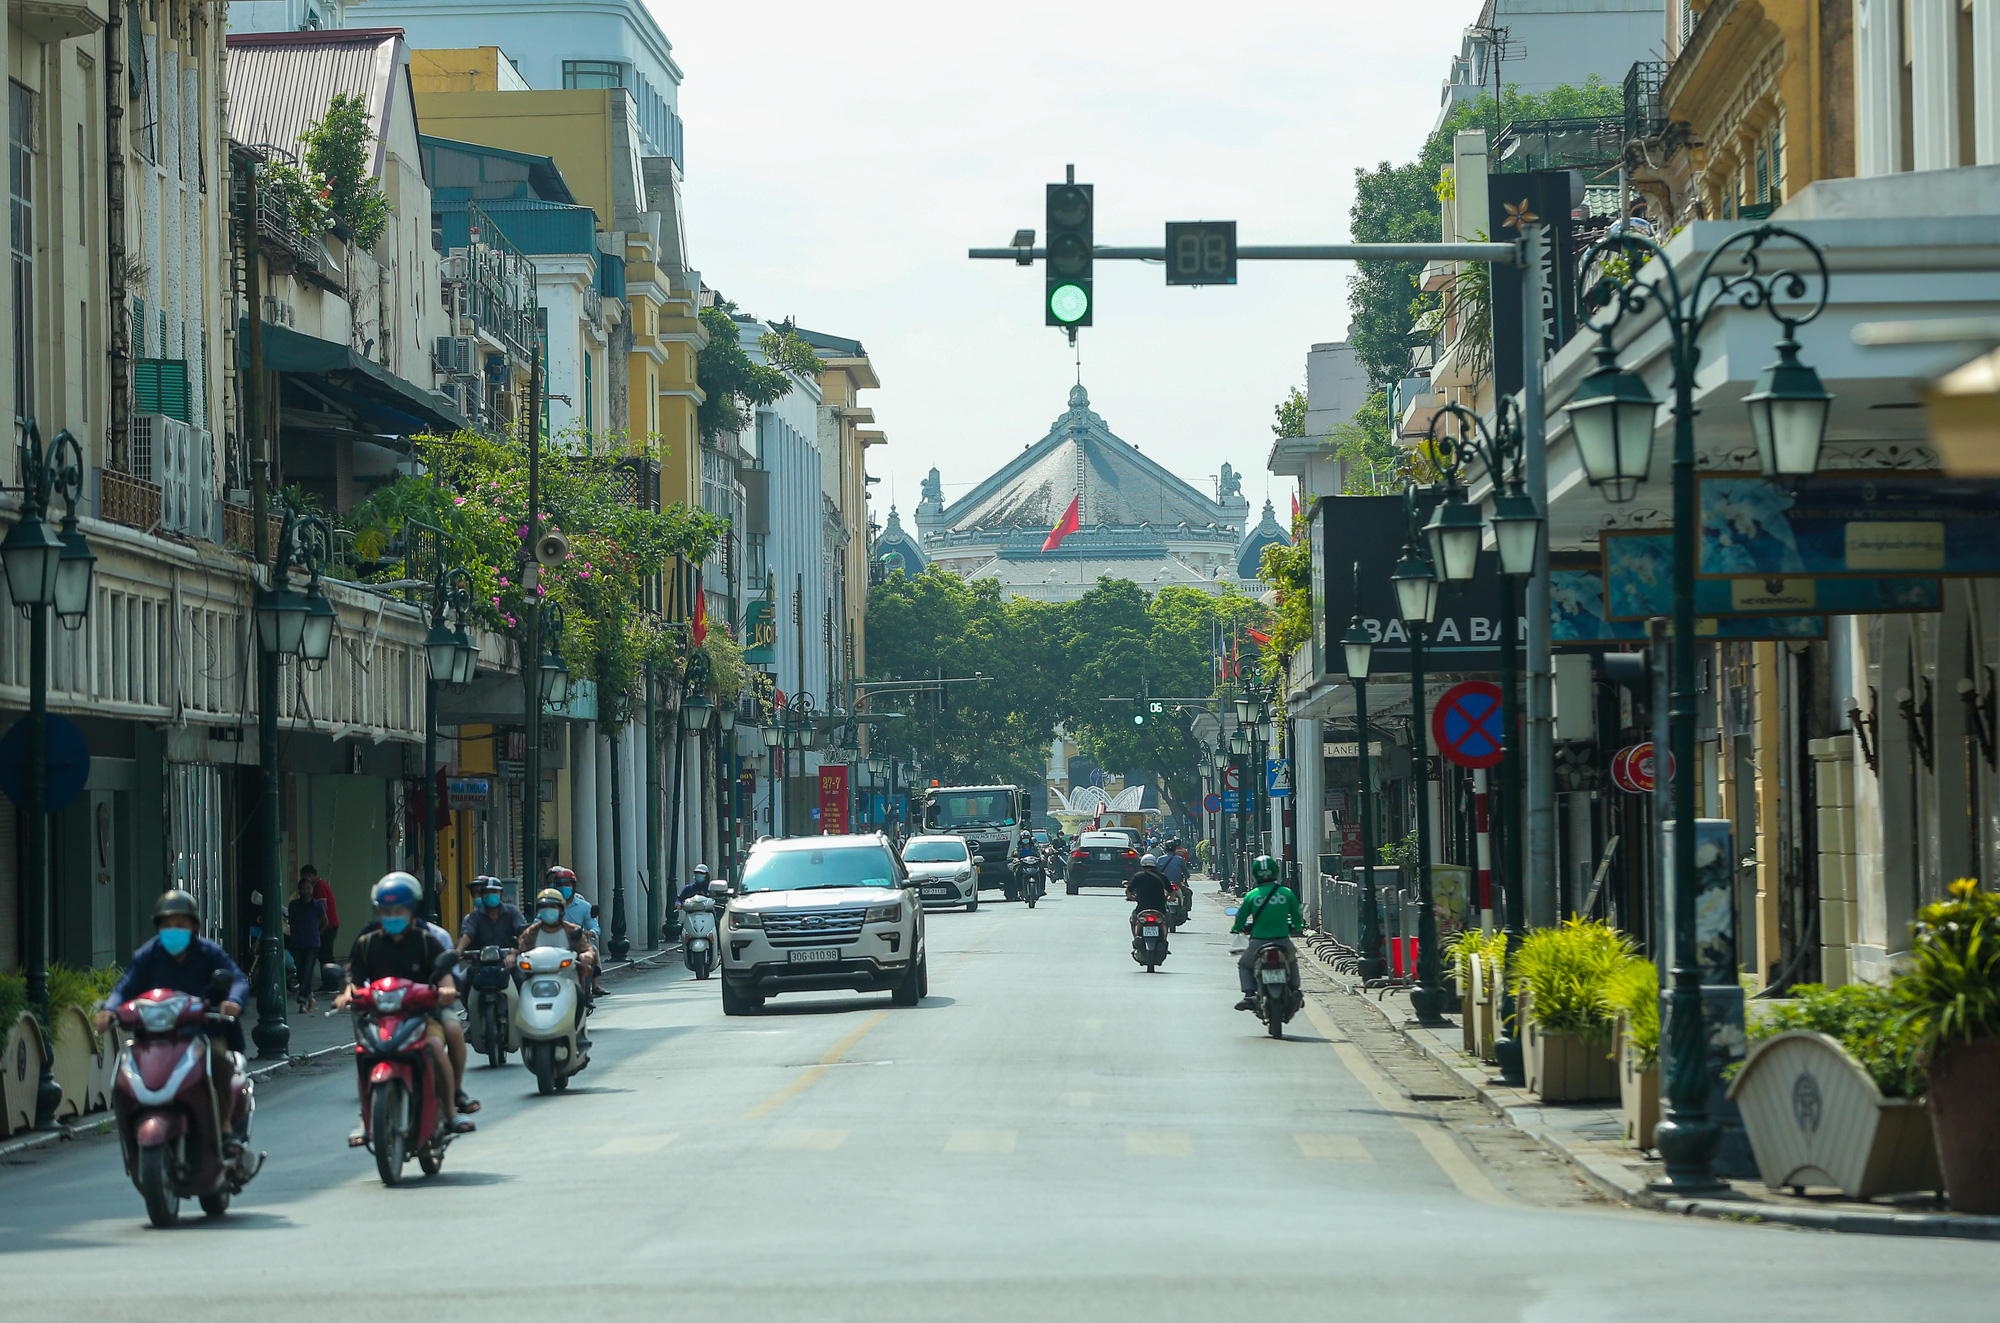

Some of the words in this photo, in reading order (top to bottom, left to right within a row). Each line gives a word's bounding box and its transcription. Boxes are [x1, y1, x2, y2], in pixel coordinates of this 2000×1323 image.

[1436, 617, 1461, 642] A
[1150, 702, 1163, 713] 06
[822, 776, 841, 790] 27-7
[451, 794, 486, 802] PHARMACY
[791, 950, 837, 962] 30G-010.98
